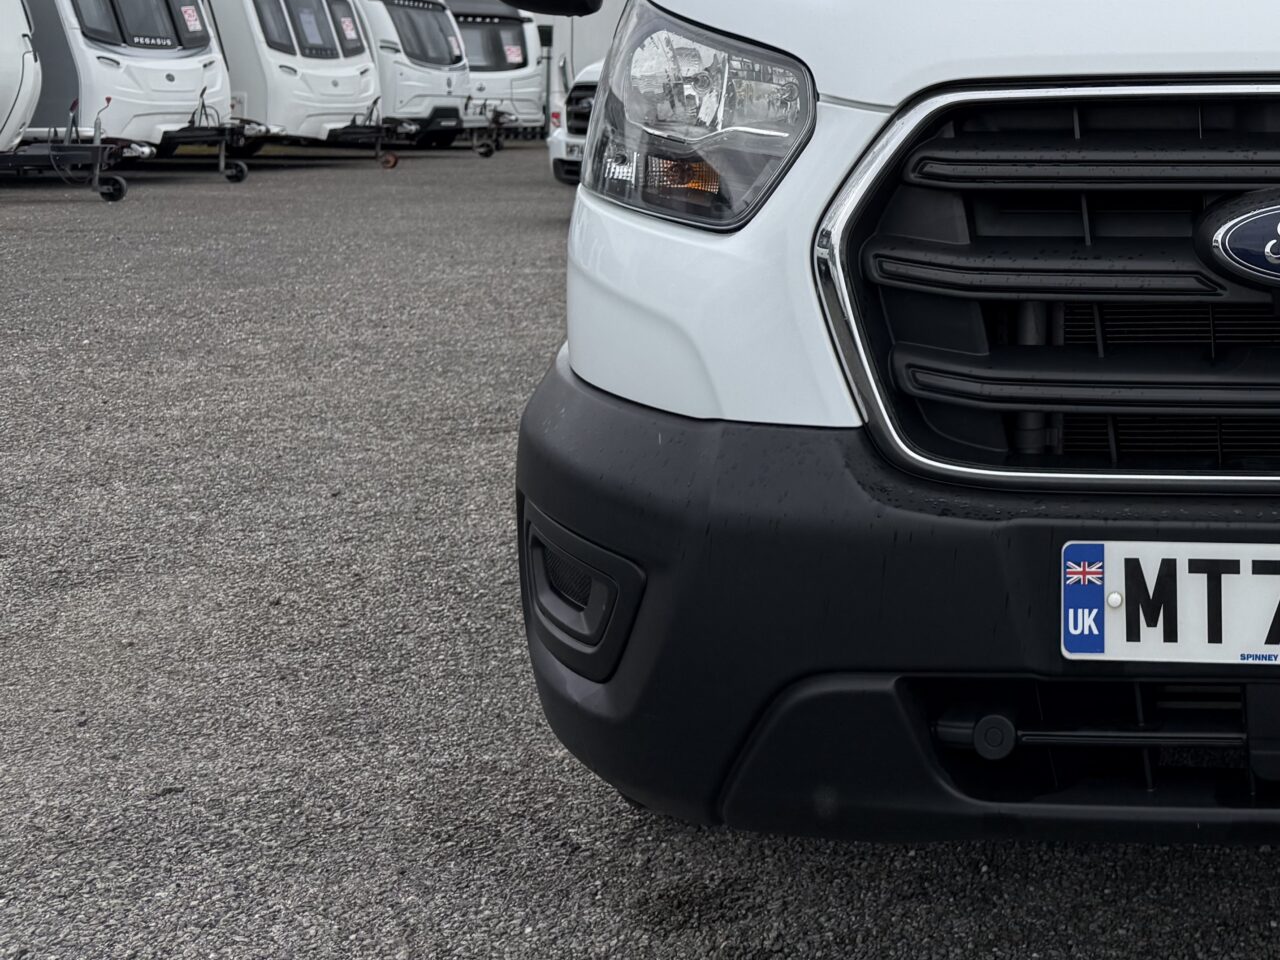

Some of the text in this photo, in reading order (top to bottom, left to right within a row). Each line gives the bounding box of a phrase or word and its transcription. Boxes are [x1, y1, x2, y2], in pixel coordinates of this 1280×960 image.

[133, 37, 172, 46] PEGASUS
[1068, 608, 1100, 635] UK
[1240, 653, 1279, 662] SPINNEY
